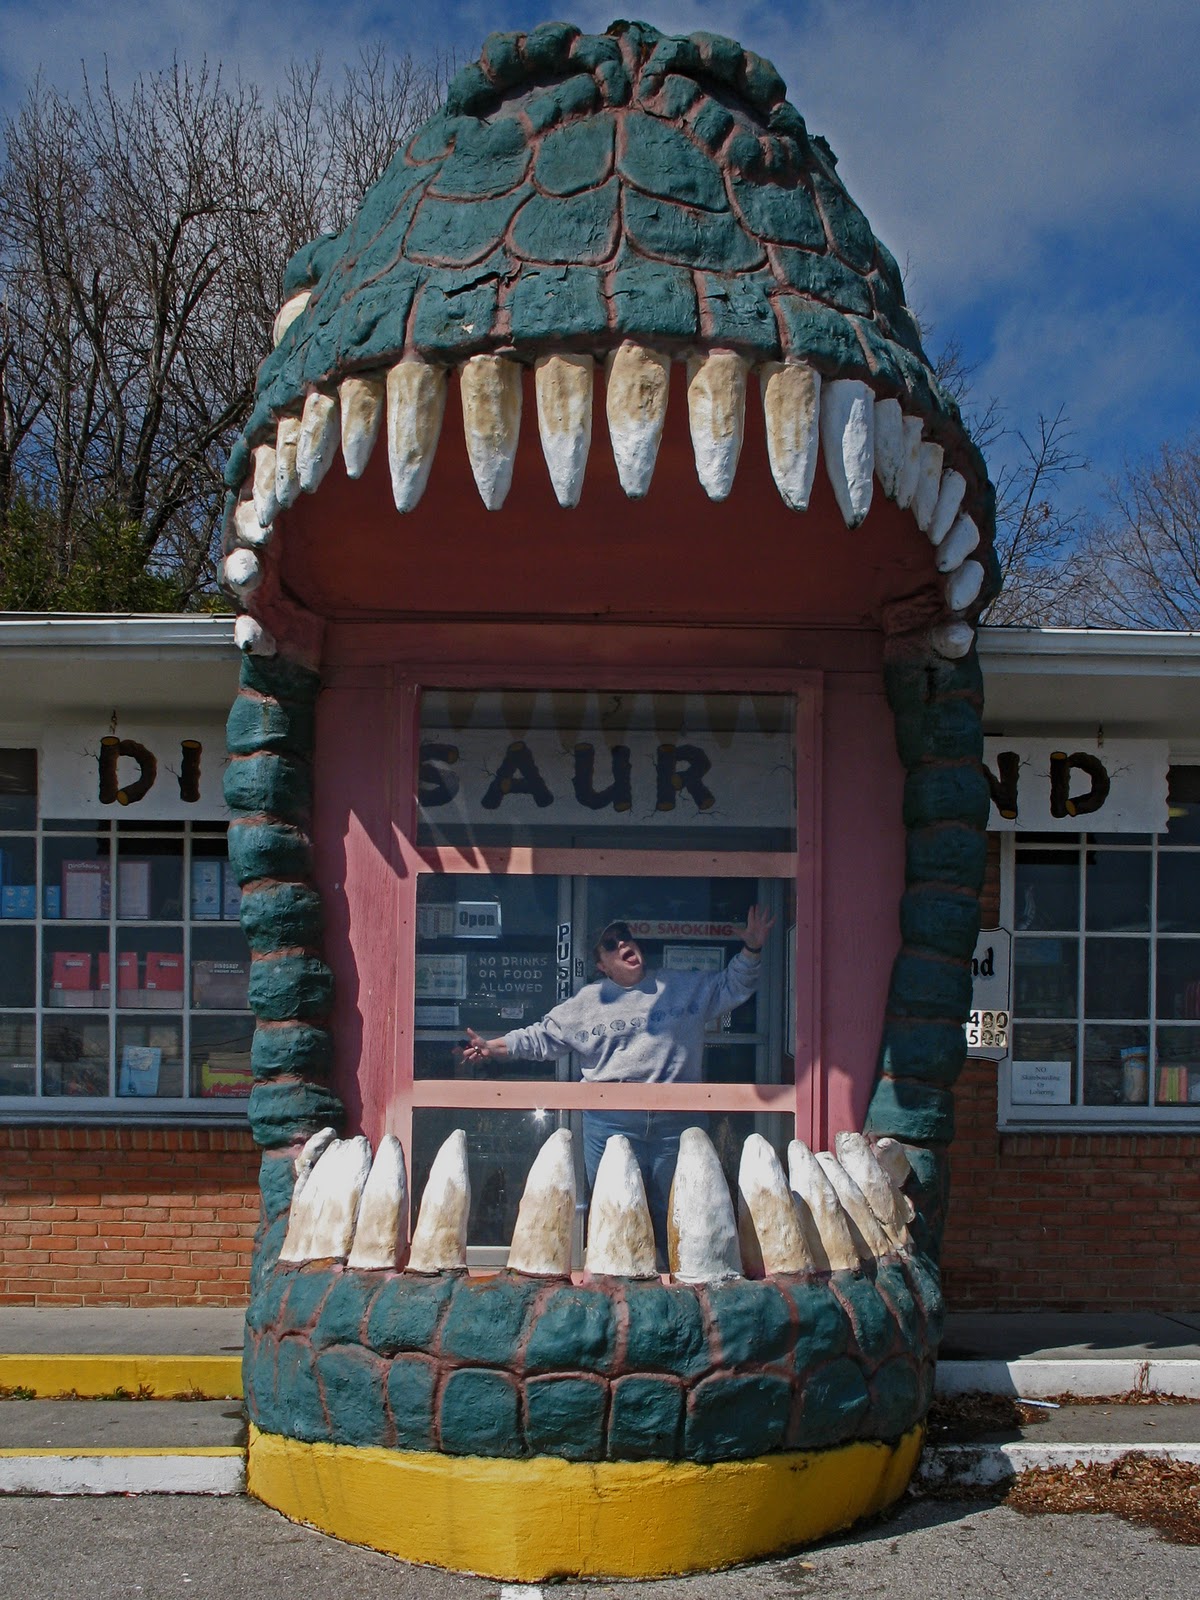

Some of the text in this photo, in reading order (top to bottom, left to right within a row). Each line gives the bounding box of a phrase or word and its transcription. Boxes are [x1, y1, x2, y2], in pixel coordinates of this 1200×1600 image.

[459, 911, 495, 928] Open
[657, 922, 733, 936] SMOKING
[479, 956, 547, 966] NO DRINKS
[558, 925, 570, 1000] PUSH
[479, 969, 543, 979] OR FOOD
[479, 982, 543, 993] ALLOWED
